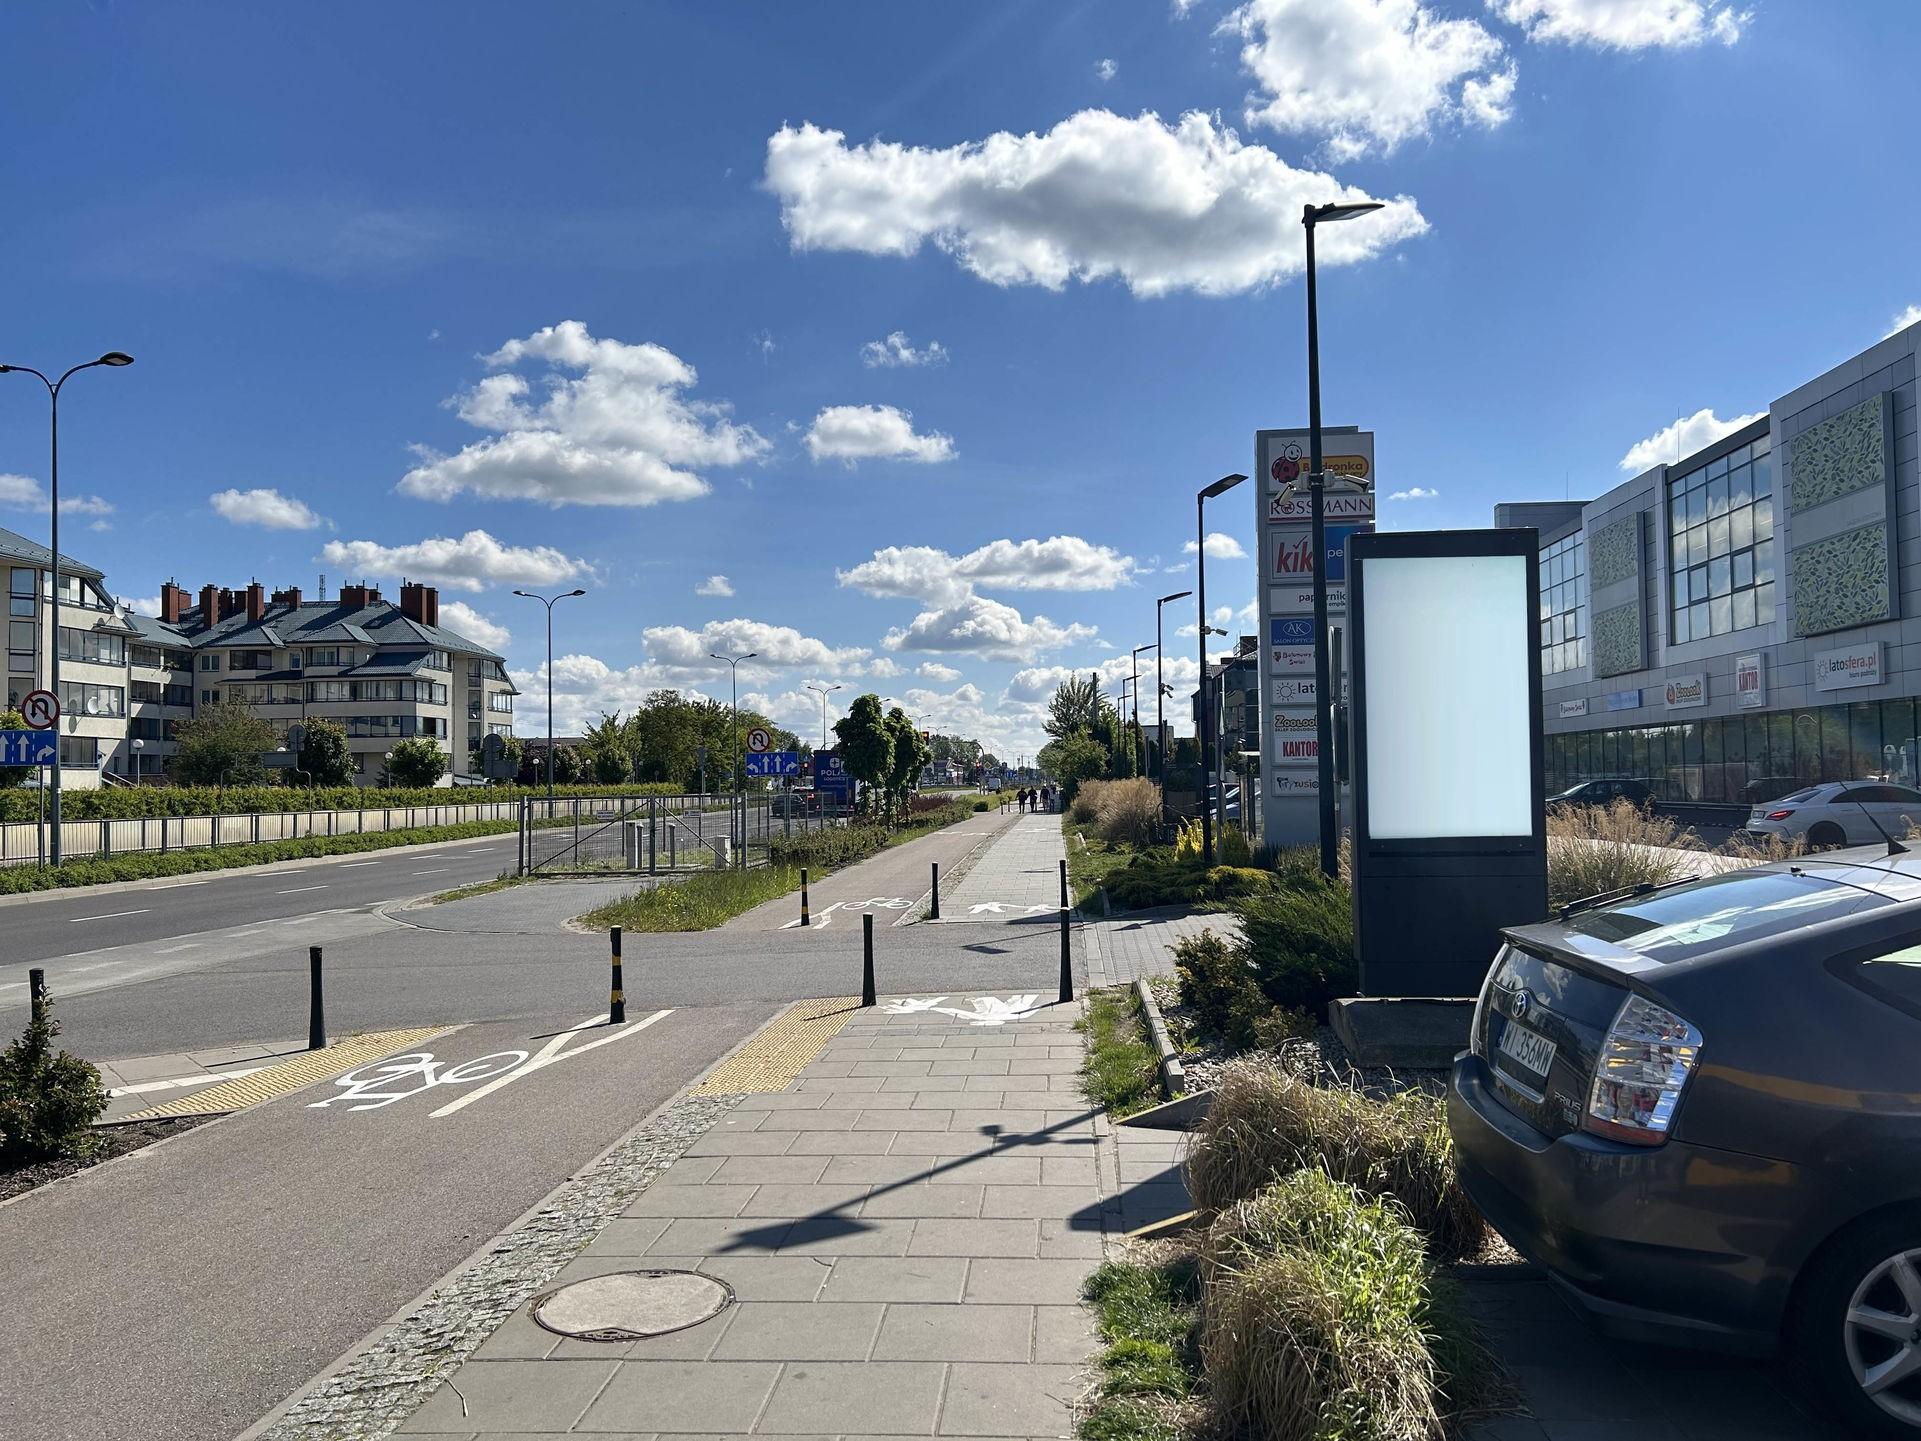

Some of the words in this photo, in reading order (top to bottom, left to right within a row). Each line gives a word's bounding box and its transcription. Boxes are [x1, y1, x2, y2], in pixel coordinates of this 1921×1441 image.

[1303, 462, 1363, 473] Bdronka
[1299, 590, 1346, 602] paprnik
[1287, 623, 1306, 635] AK
[1829, 651, 1877, 672] latosfera.pl
[1282, 740, 1318, 757] KANTOR
